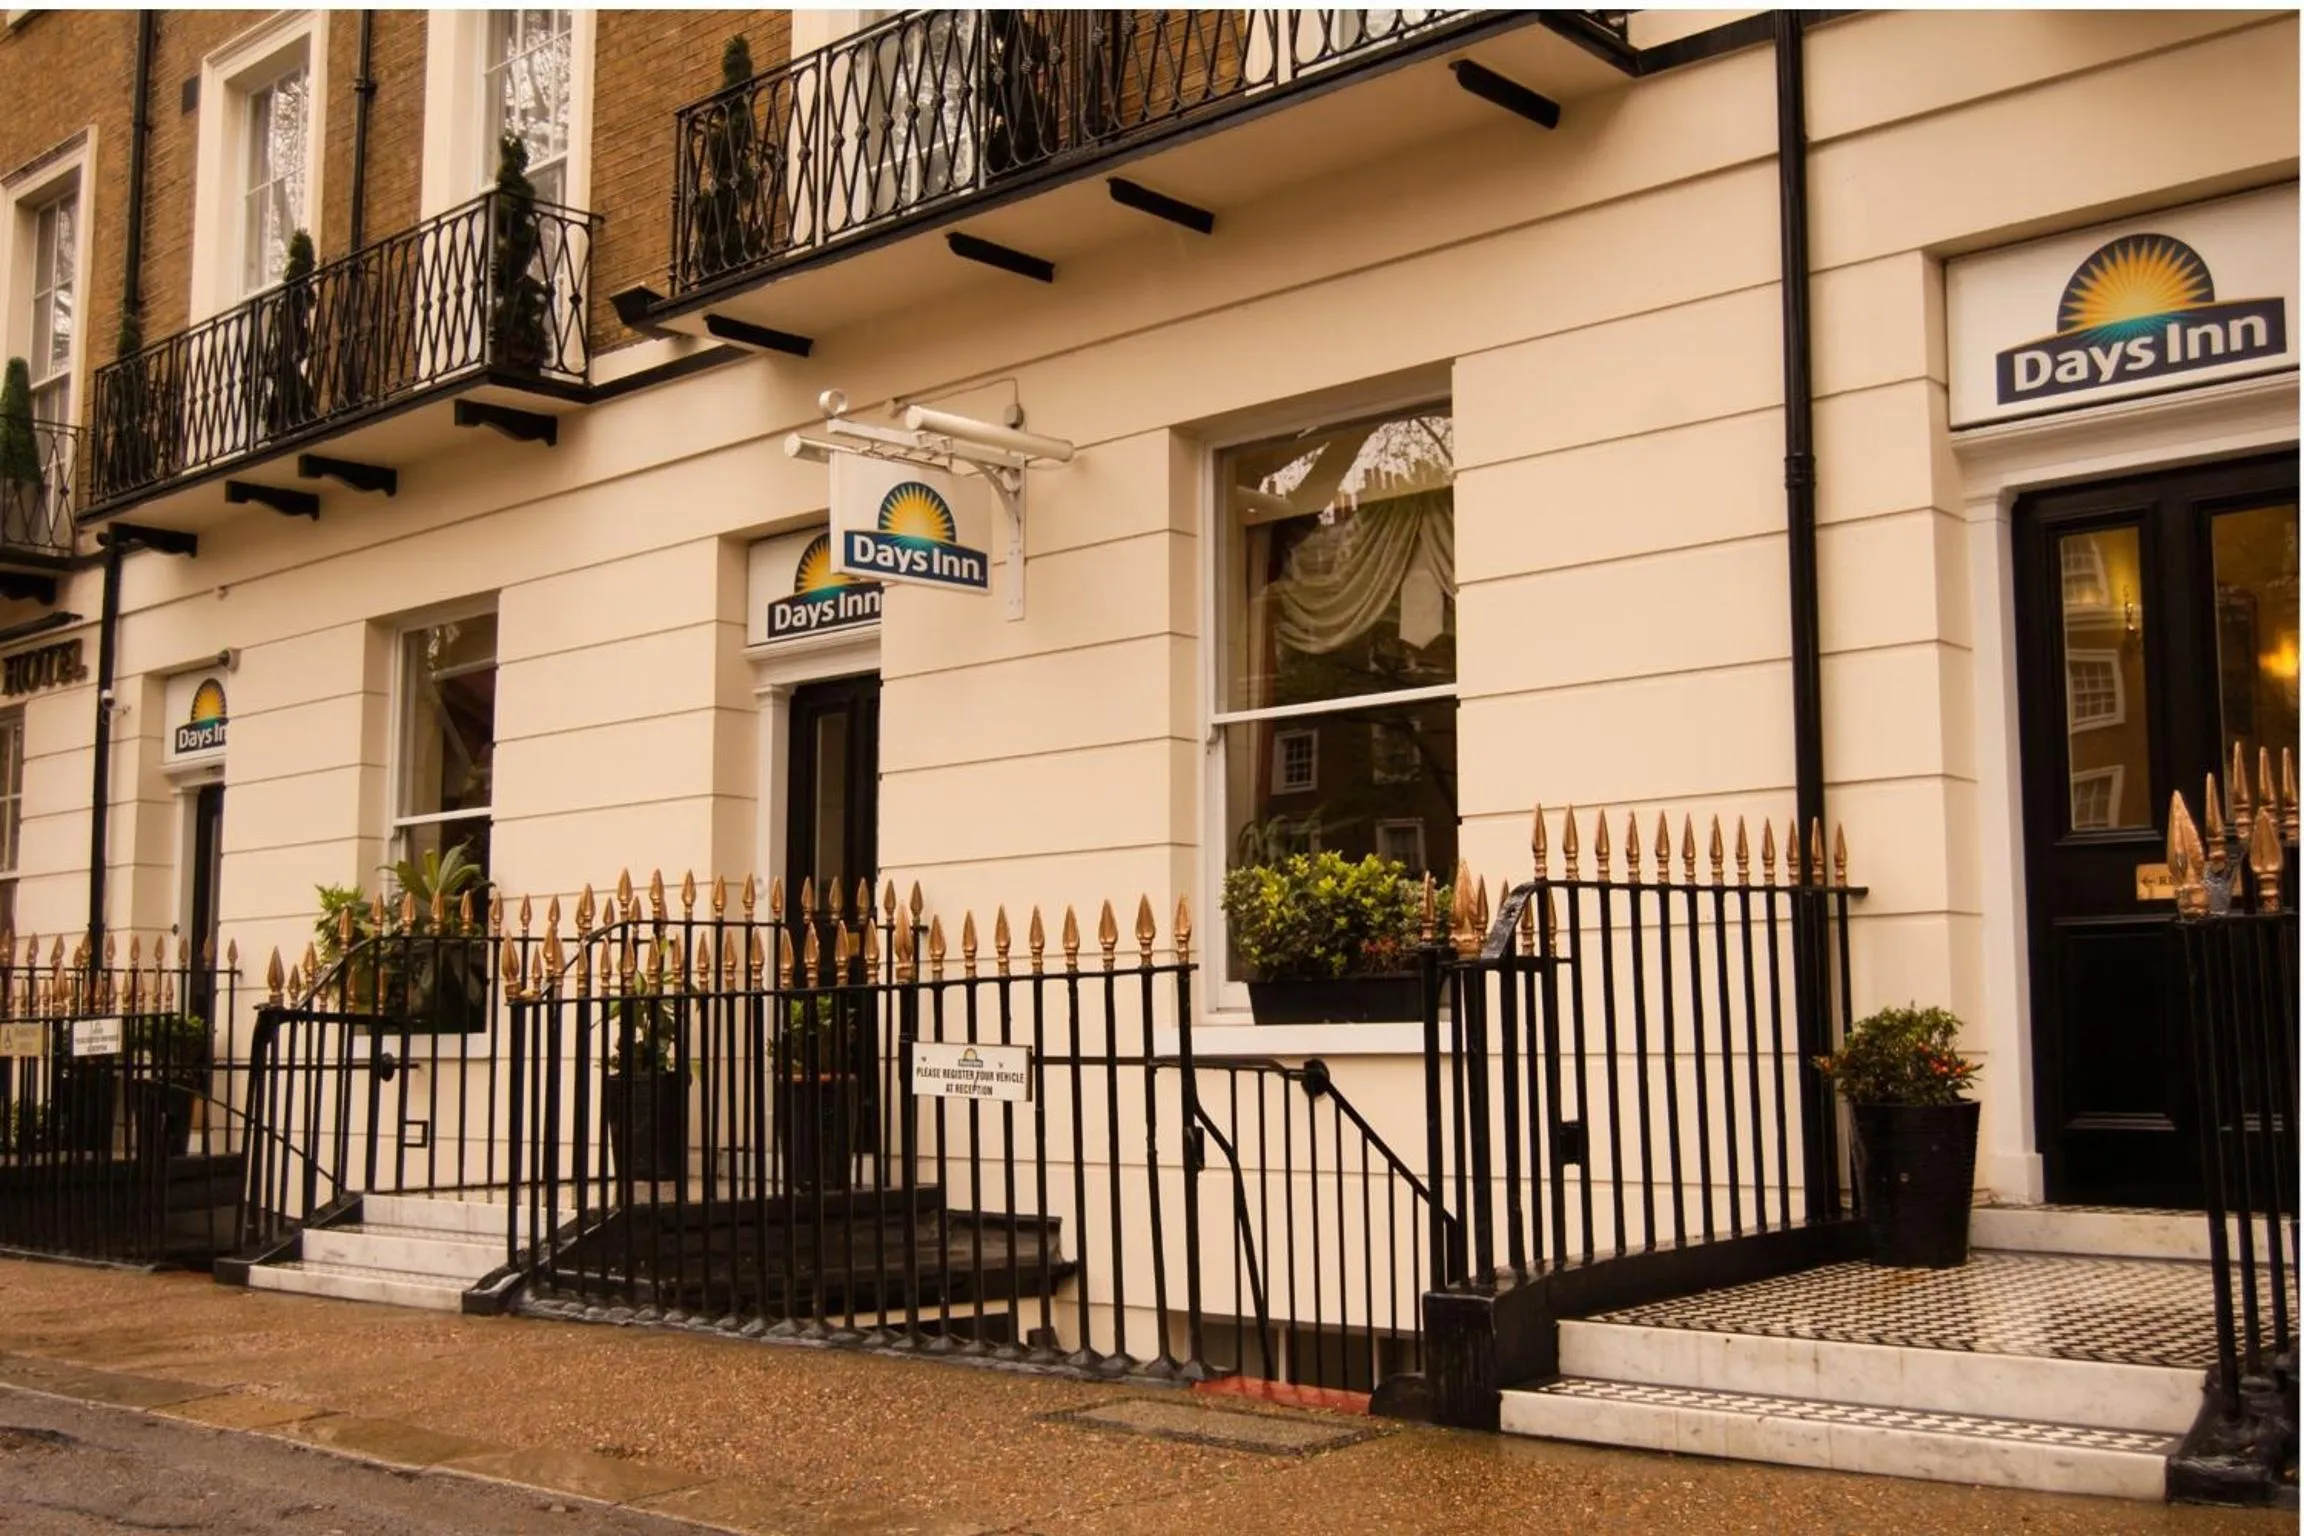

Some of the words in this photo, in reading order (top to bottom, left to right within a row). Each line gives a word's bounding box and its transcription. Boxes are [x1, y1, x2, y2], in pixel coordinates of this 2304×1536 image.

[2013, 335, 2156, 392] Days
[2166, 314, 2268, 364] Inn
[853, 534, 928, 573] Days
[933, 547, 980, 580] Inn
[774, 597, 835, 630] Days
[839, 590, 881, 618] Inn
[3, 638, 88, 696] HOTEL
[178, 727, 213, 749] Days
[916, 1067, 941, 1079] PLEASE
[942, 1068, 974, 1080] REGISTER
[996, 1071, 1025, 1084] VEHICLE
[945, 1083, 953, 1092] AT
[955, 1084, 993, 1095] RECEPTION
